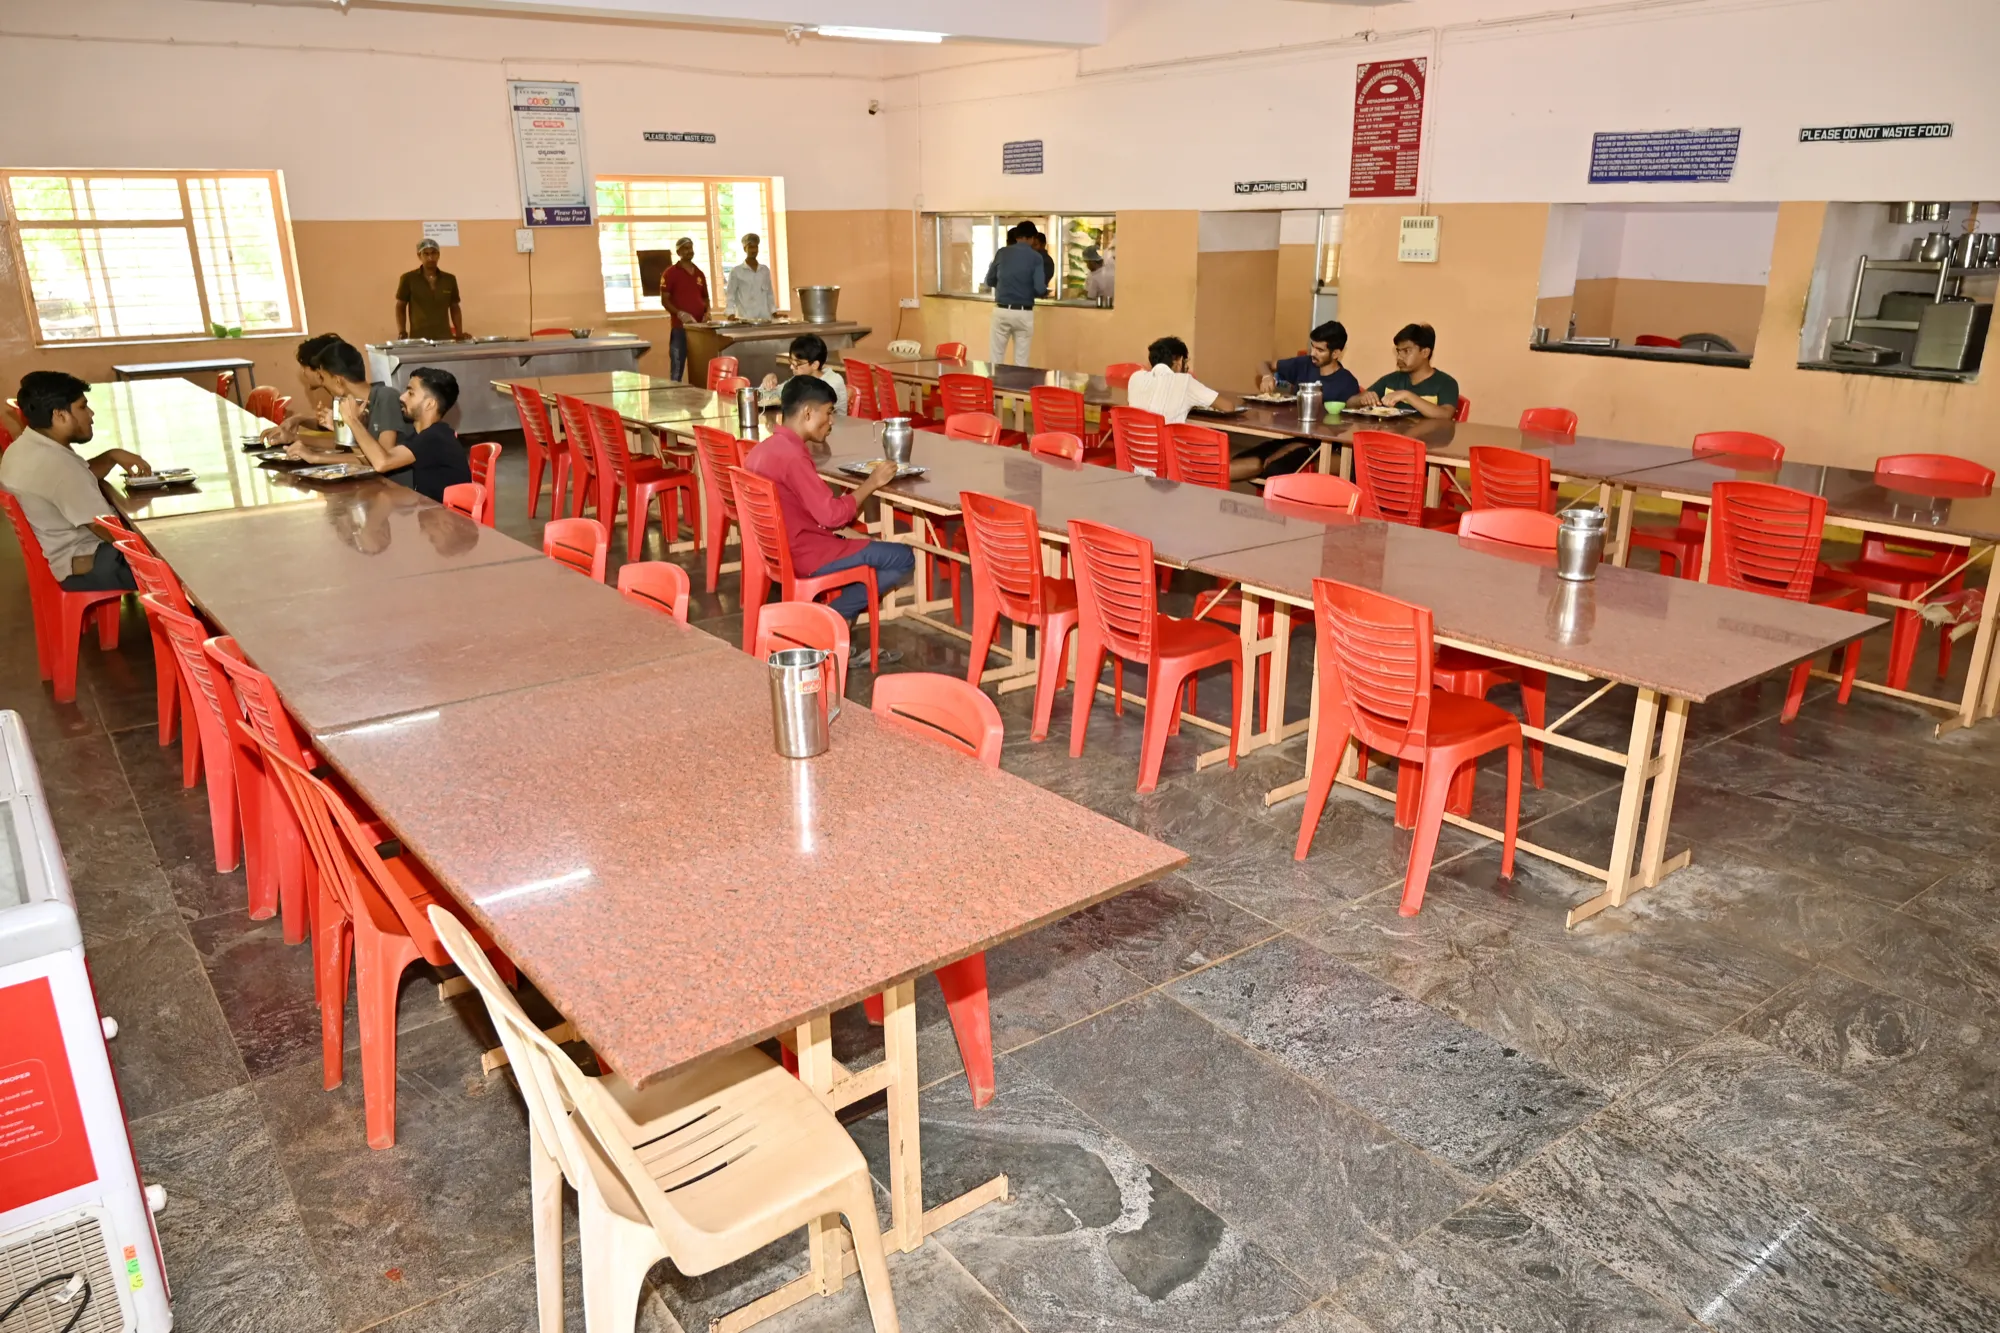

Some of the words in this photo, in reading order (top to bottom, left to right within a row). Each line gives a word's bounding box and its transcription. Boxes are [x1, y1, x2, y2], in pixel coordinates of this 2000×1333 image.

[1801, 129, 1841, 140] PLEASE
[1843, 129, 1857, 139] DO
[1859, 128, 1880, 138] NOT
[1882, 126, 1916, 137] WASTE
[1918, 125, 1949, 136] FOOD
[1253, 182, 1304, 191] ADMISSION
